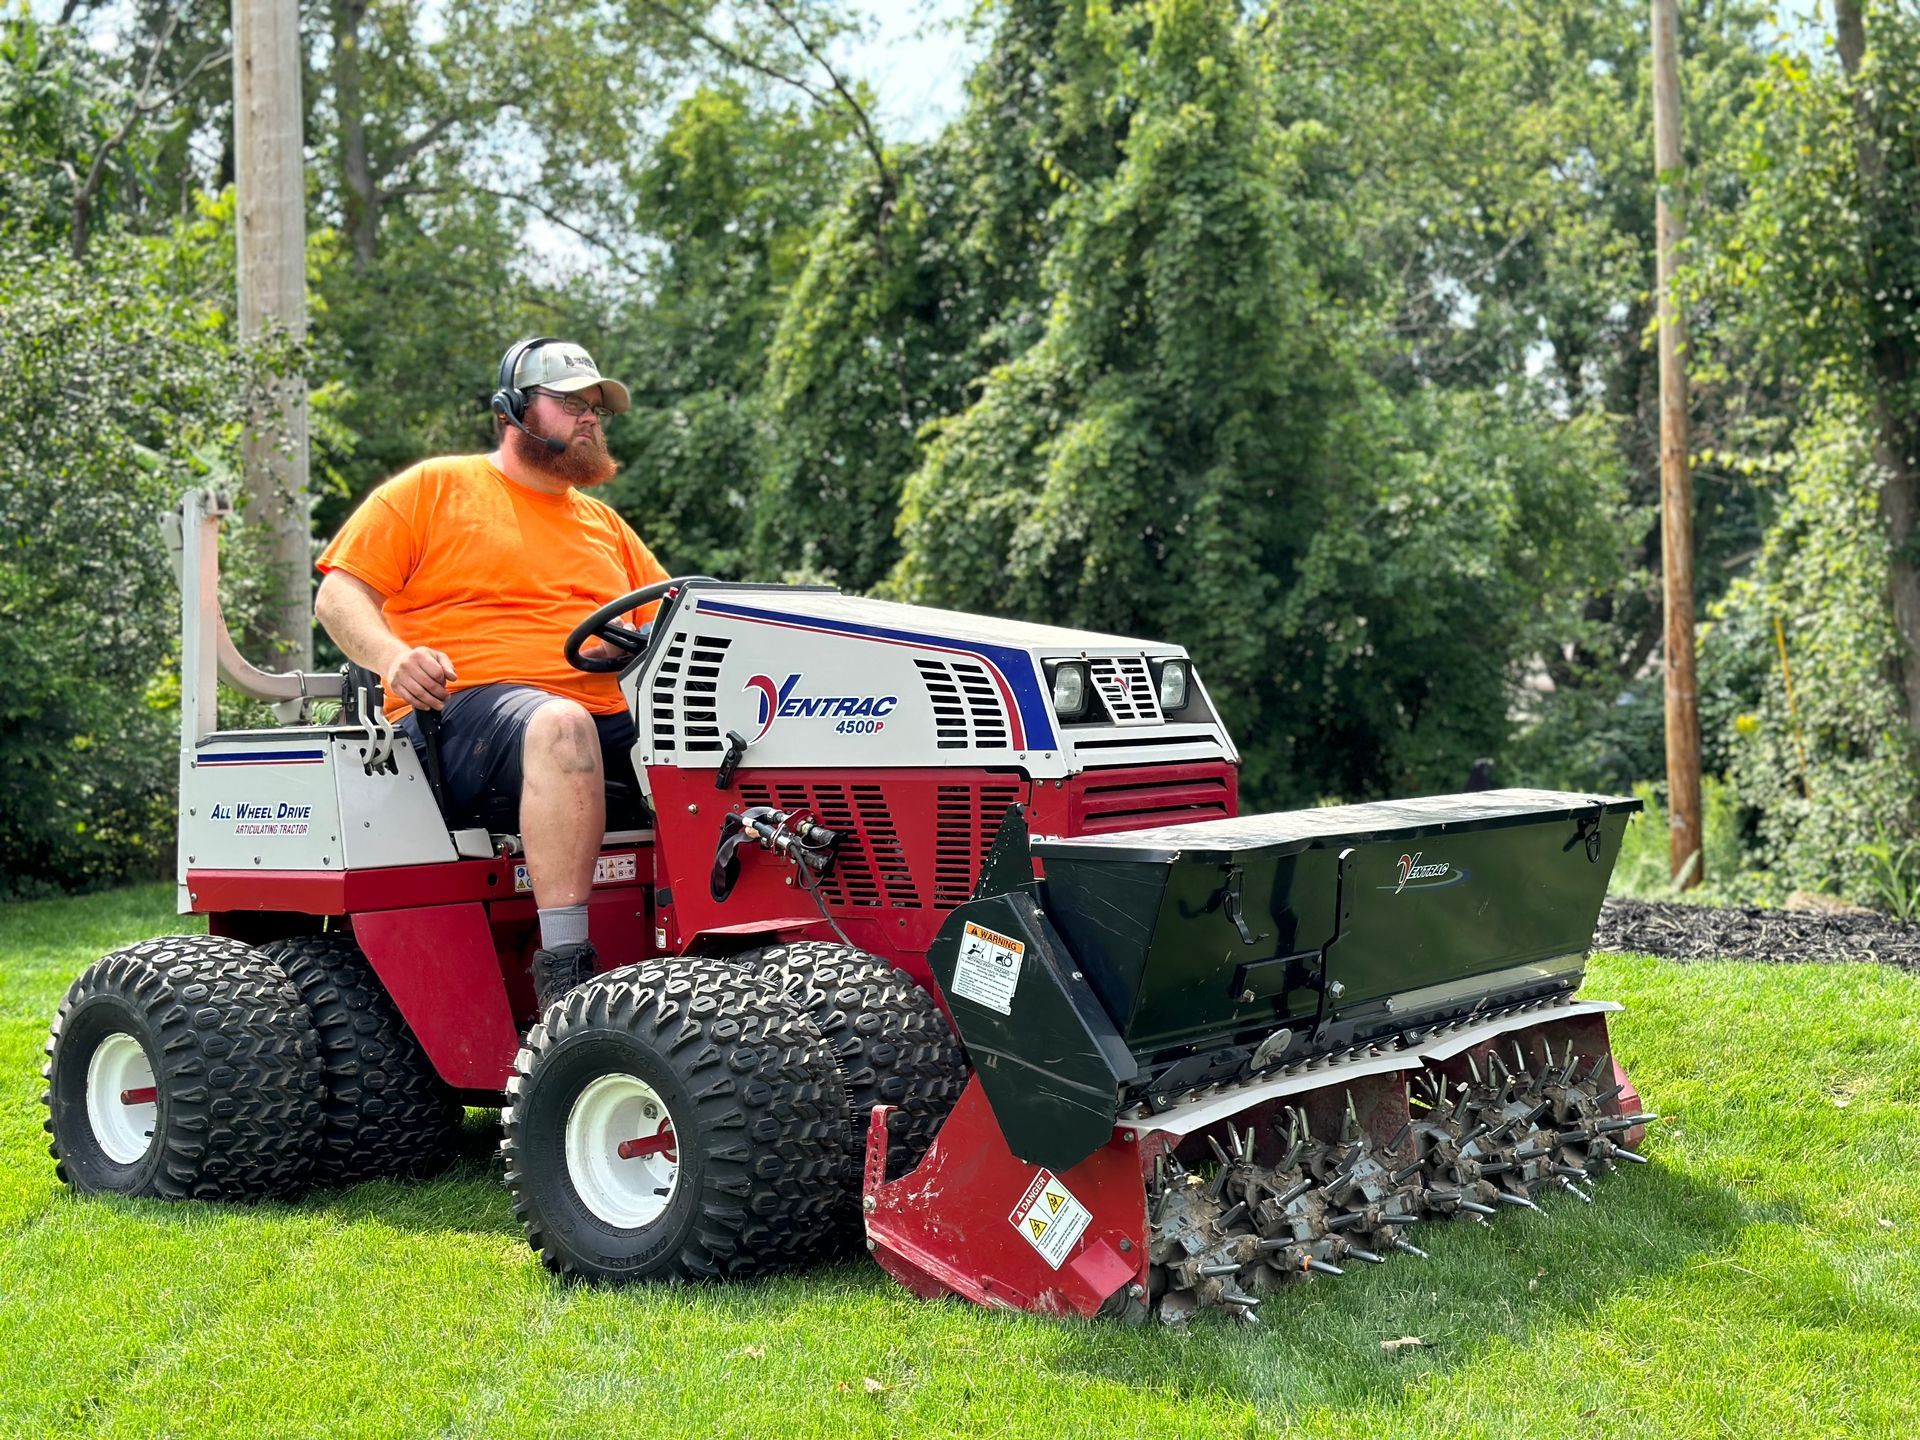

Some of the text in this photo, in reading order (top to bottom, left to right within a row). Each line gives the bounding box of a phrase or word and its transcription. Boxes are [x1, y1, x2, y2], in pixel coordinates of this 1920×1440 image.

[744, 674, 898, 743] VENTRAC
[835, 720, 884, 734] 4500P
[211, 803, 311, 819] ALL WHEEL DRIVE
[235, 824, 308, 835] ARTICULATING TRACTOR
[1395, 851, 1450, 895] VENTRAC
[981, 930, 1017, 951] WARNING
[1021, 1176, 1047, 1211] DANGER
